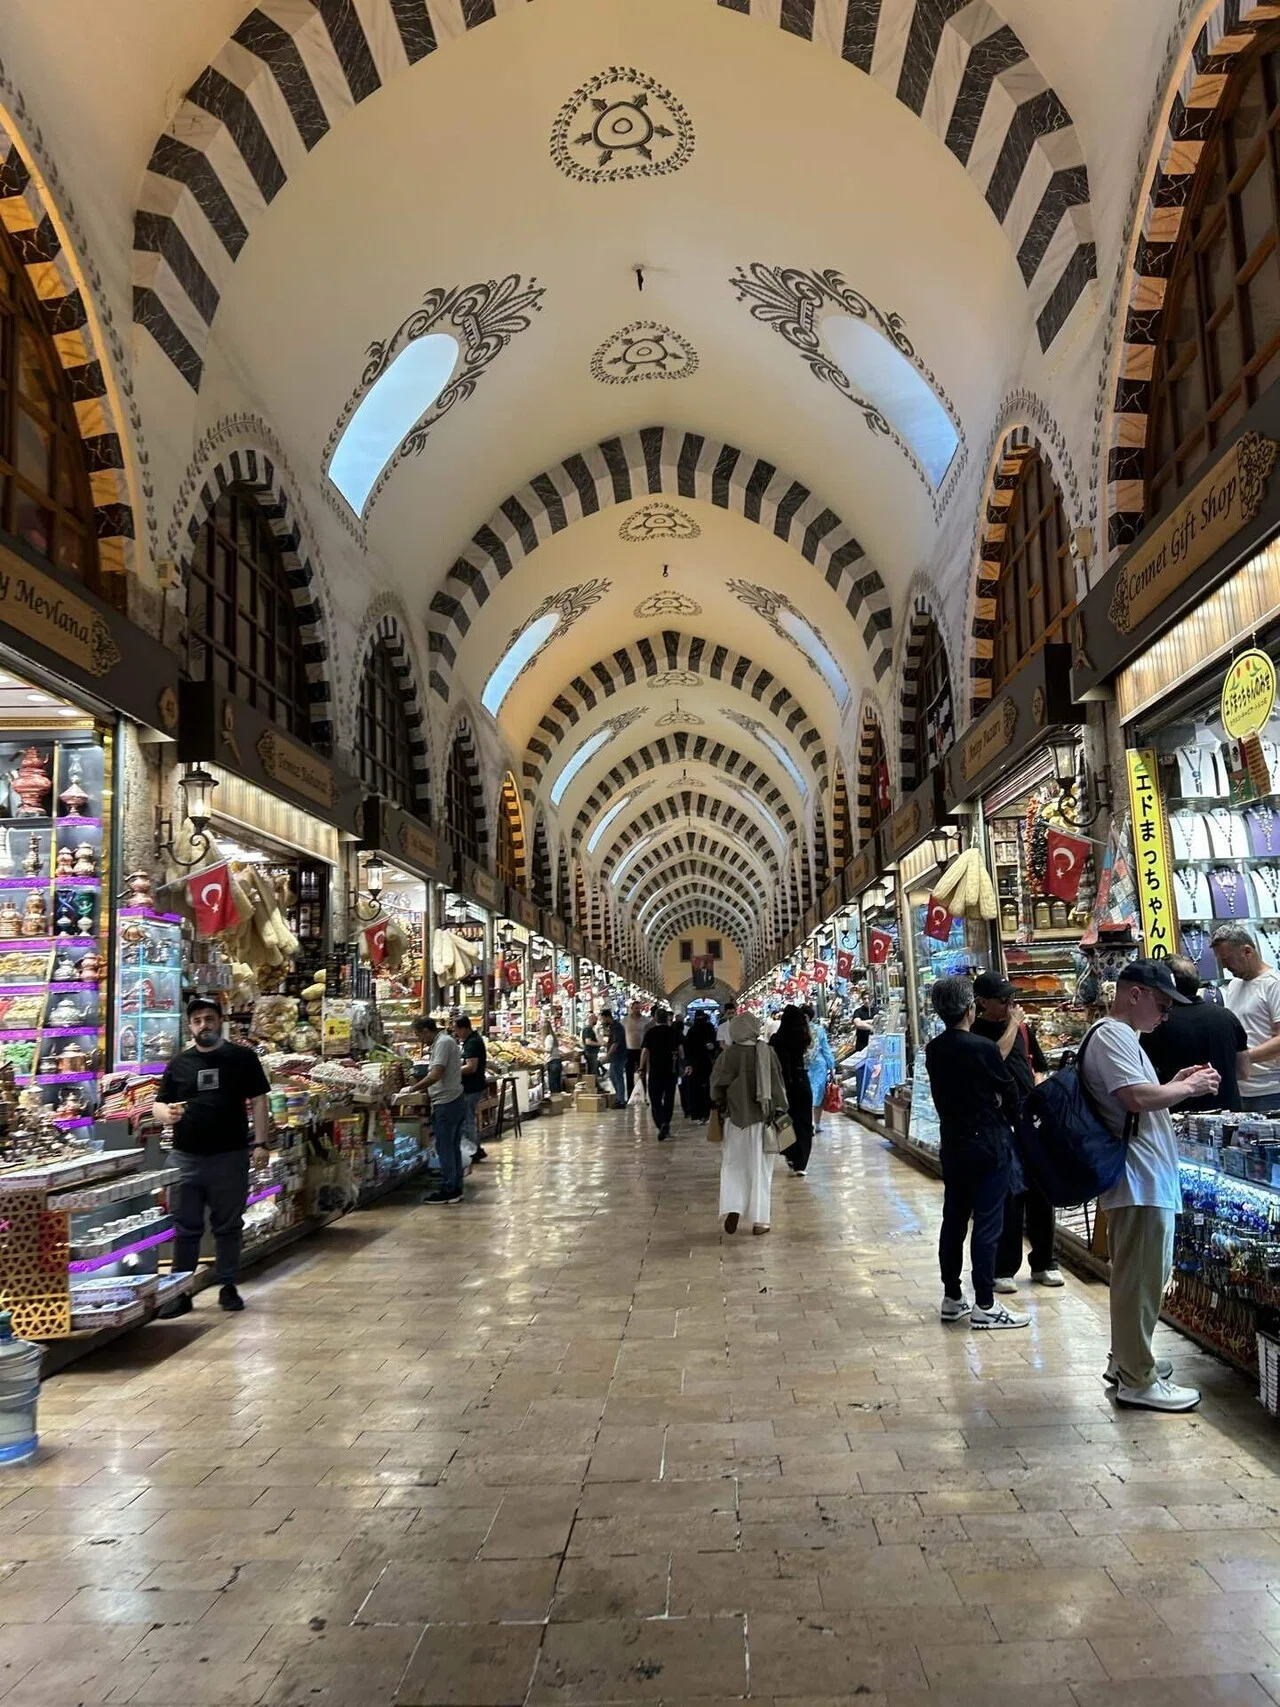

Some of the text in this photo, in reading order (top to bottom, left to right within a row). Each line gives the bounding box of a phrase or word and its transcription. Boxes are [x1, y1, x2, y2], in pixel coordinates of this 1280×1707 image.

[1129, 477, 1236, 600] Cennet Gift Shop
[0, 570, 89, 644] y Mevlana
[1136, 774, 1168, 960] エドまっちゃんの
